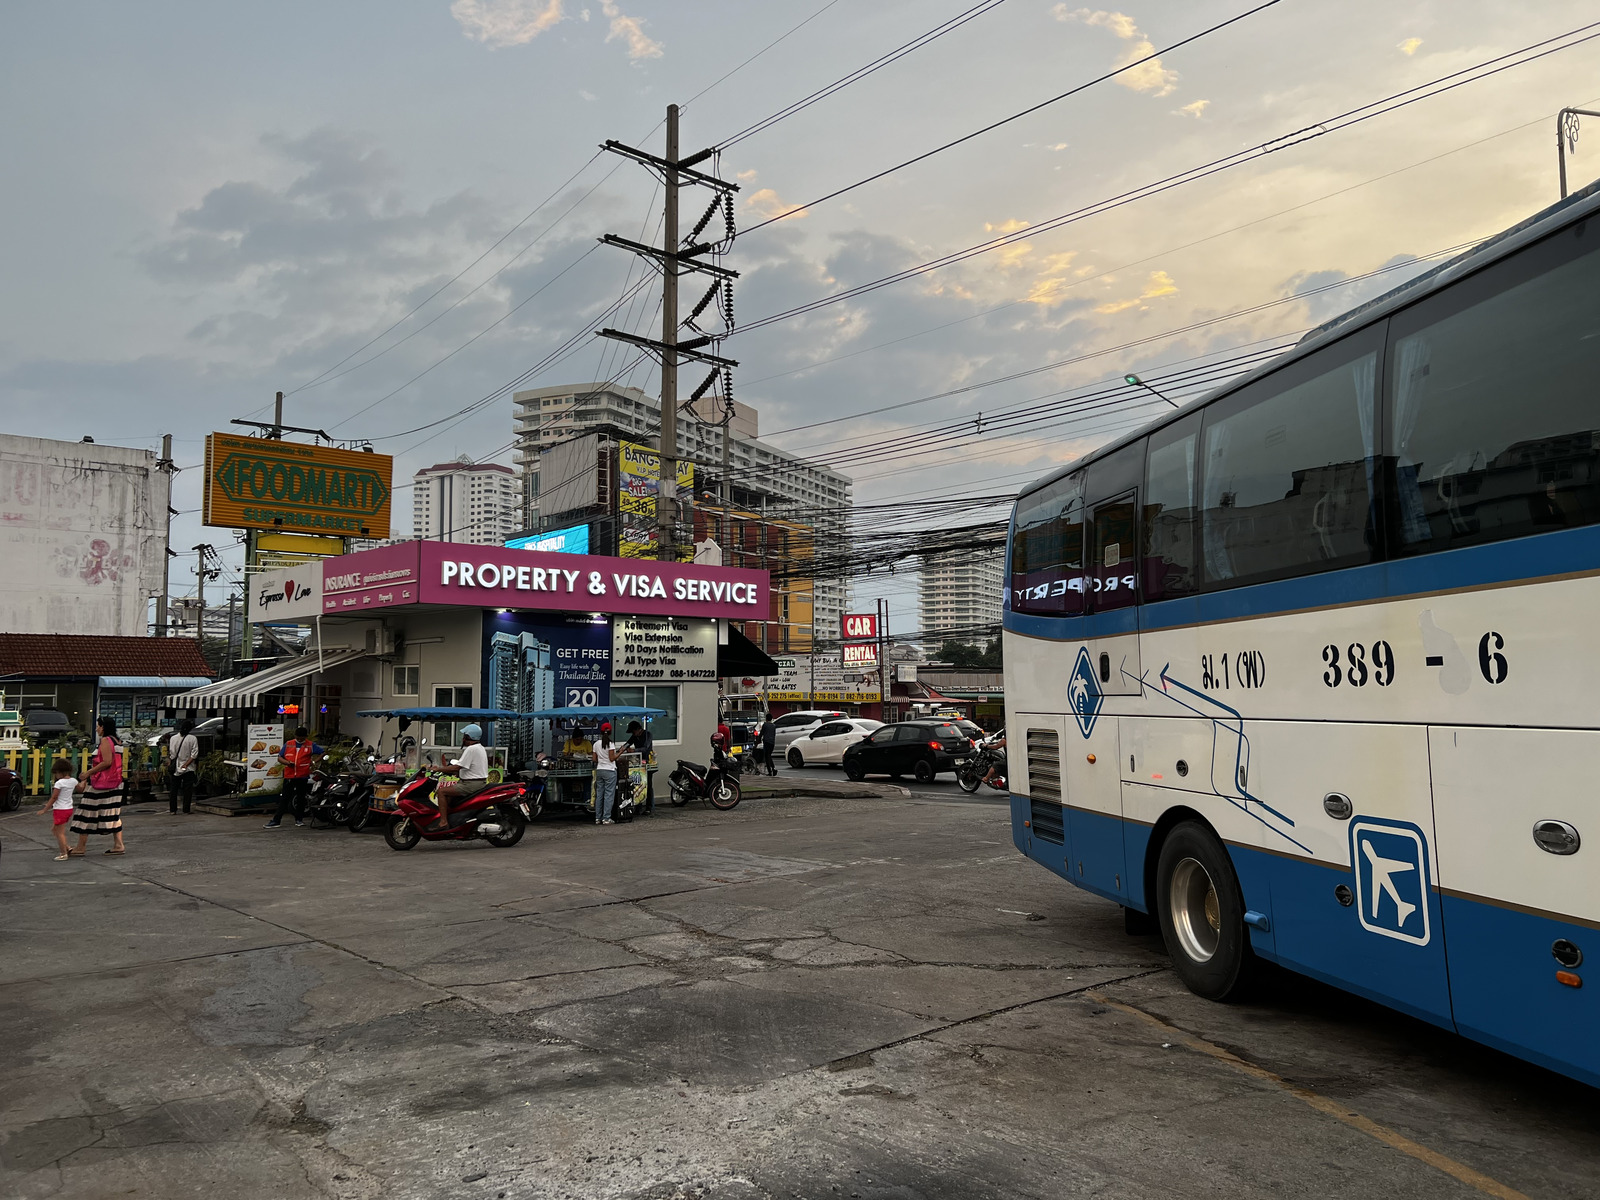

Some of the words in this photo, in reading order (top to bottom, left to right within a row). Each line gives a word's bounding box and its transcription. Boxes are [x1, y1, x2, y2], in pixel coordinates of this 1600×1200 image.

[238, 459, 372, 508] FOODMART
[628, 486, 648, 497] SALE!
[243, 508, 365, 531] SUPERMARKET
[325, 572, 361, 591] INSURANCE
[441, 560, 580, 593] PROPERTY
[586, 571, 606, 595] &
[612, 573, 667, 599] VISA
[672, 578, 757, 604] SERVICE
[624, 620, 669, 631] Retirement
[671, 621, 689, 631] Visa
[846, 617, 871, 636] CAR
[624, 632, 643, 642] Visa
[645, 633, 682, 643] Extension
[556, 648, 579, 659] GET
[581, 649, 609, 660] FREE
[624, 645, 634, 653] 90
[636, 645, 657, 655] Days
[659, 645, 704, 655] Notification
[844, 646, 875, 661] RENTAL
[624, 656, 635, 665] All
[637, 656, 657, 667] Type
[659, 656, 676, 665] Visa
[1321, 639, 1395, 688] 389
[1425, 655, 1444, 667] -
[1478, 631, 1509, 685] 6
[559, 670, 590, 680] Thailand
[588, 669, 606, 683] Elite
[615, 669, 664, 678] 094-4293289
[670, 669, 715, 678] 088-1847228
[568, 689, 597, 708] 20
[808, 692, 838, 700] 02-716-0194
